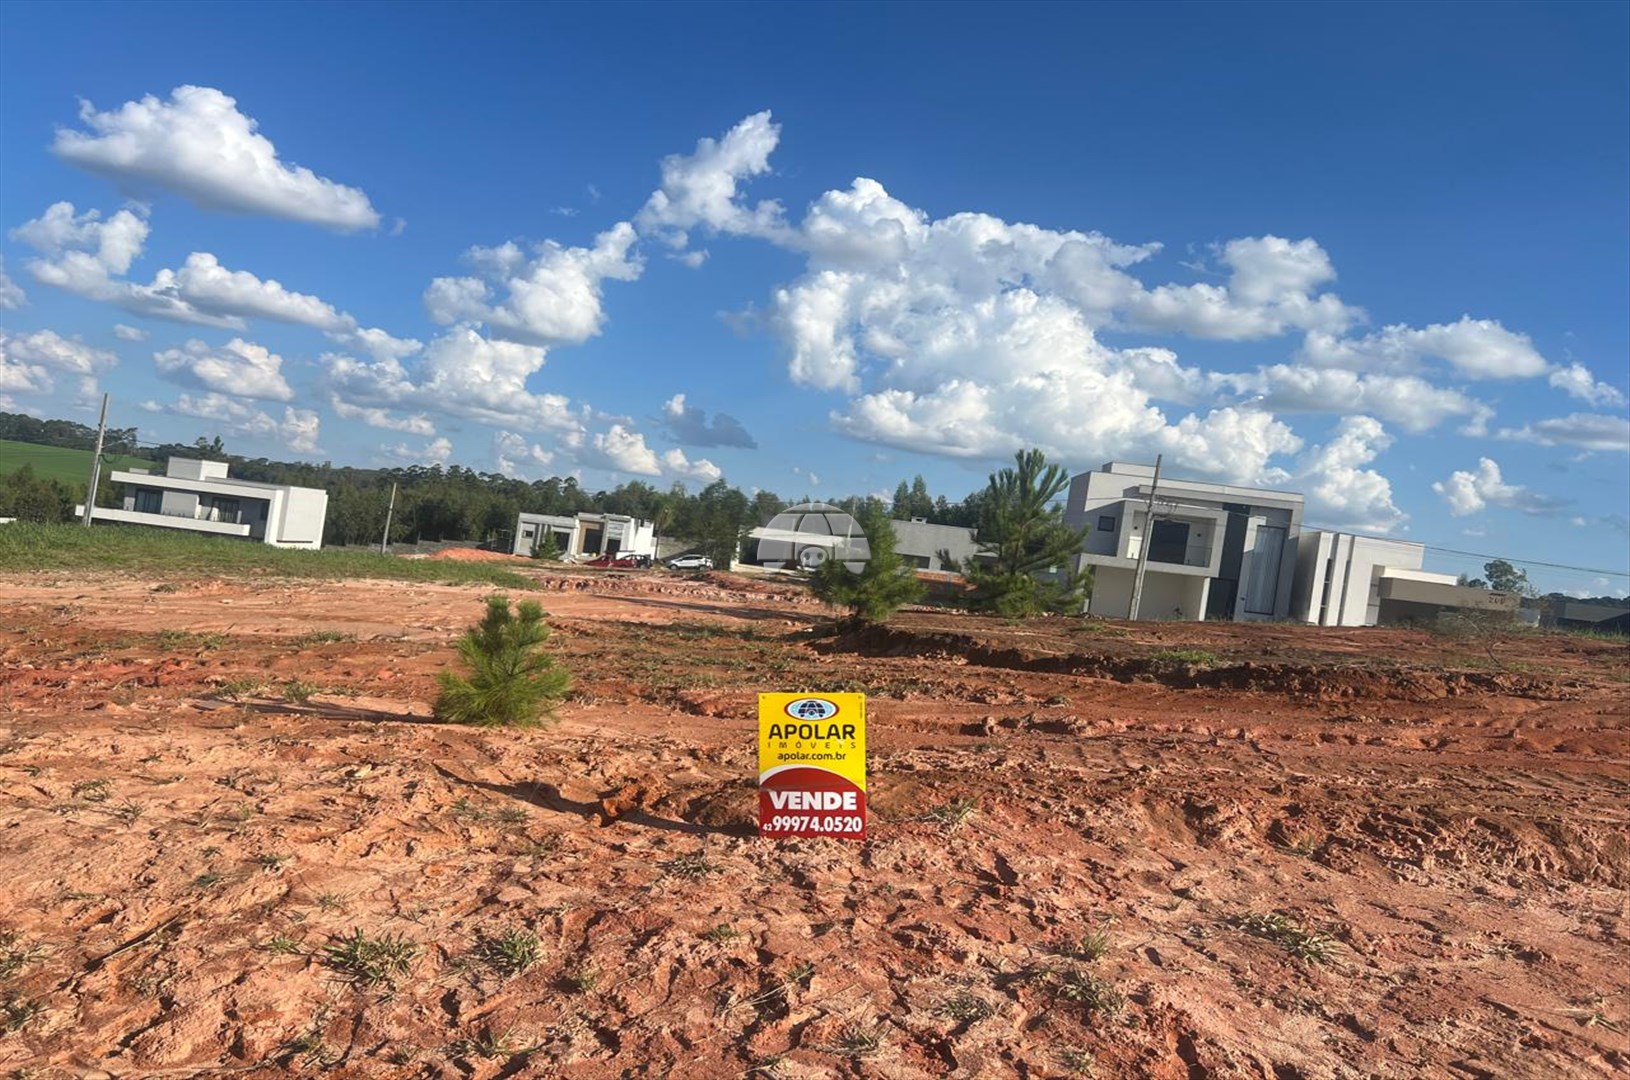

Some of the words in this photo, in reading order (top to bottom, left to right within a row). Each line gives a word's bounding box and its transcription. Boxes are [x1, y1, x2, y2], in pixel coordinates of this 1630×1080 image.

[768, 724, 856, 740] APOLAR
[777, 751, 847, 762] apolar.com.br
[768, 791, 857, 811] VENDE
[772, 816, 863, 832] 99974.0520
